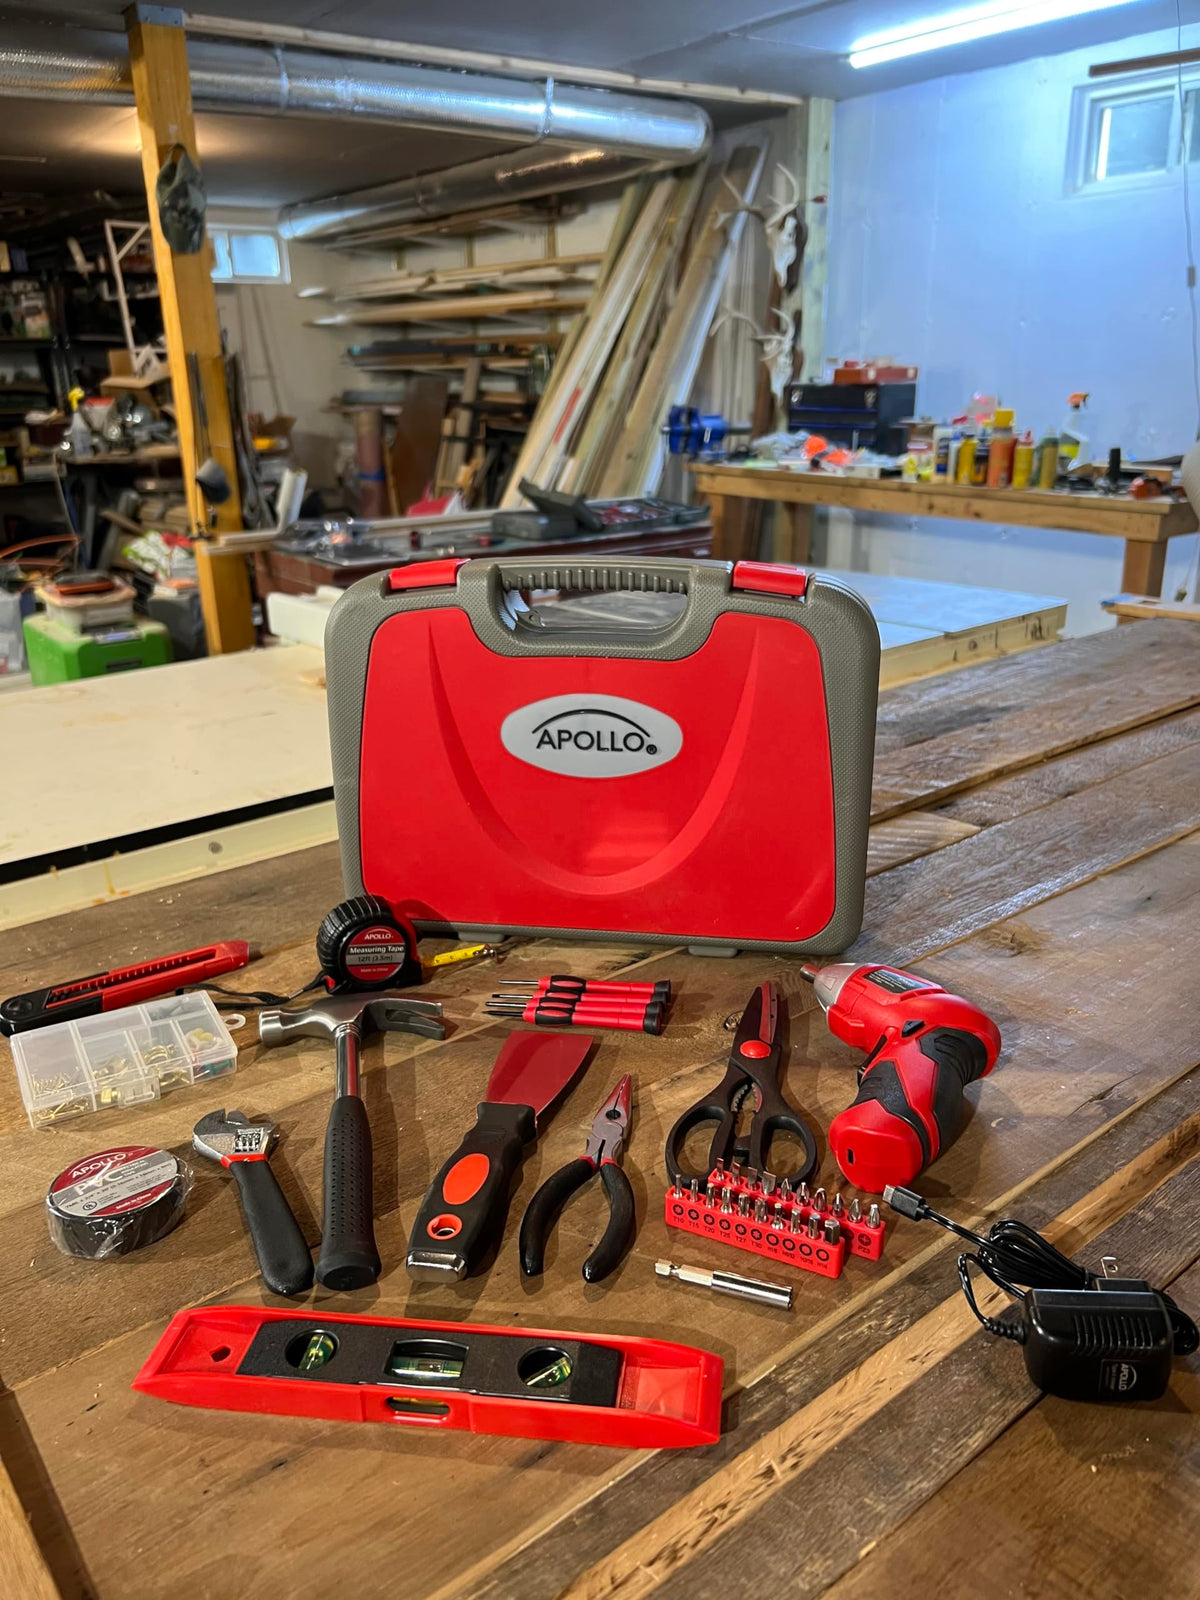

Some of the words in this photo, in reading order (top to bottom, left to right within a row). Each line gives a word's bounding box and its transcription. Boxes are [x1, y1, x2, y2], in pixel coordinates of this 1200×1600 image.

[349, 946, 387, 954] Measuring
[72, 1153, 126, 1178] APOLLO
[74, 1167, 123, 1195] PVC
[673, 1215, 685, 1224] T10
[689, 1220, 700, 1229] T15
[704, 1225, 715, 1234] T20
[735, 1235, 747, 1243] T27
[1119, 1363, 1130, 1391] APOLLO
